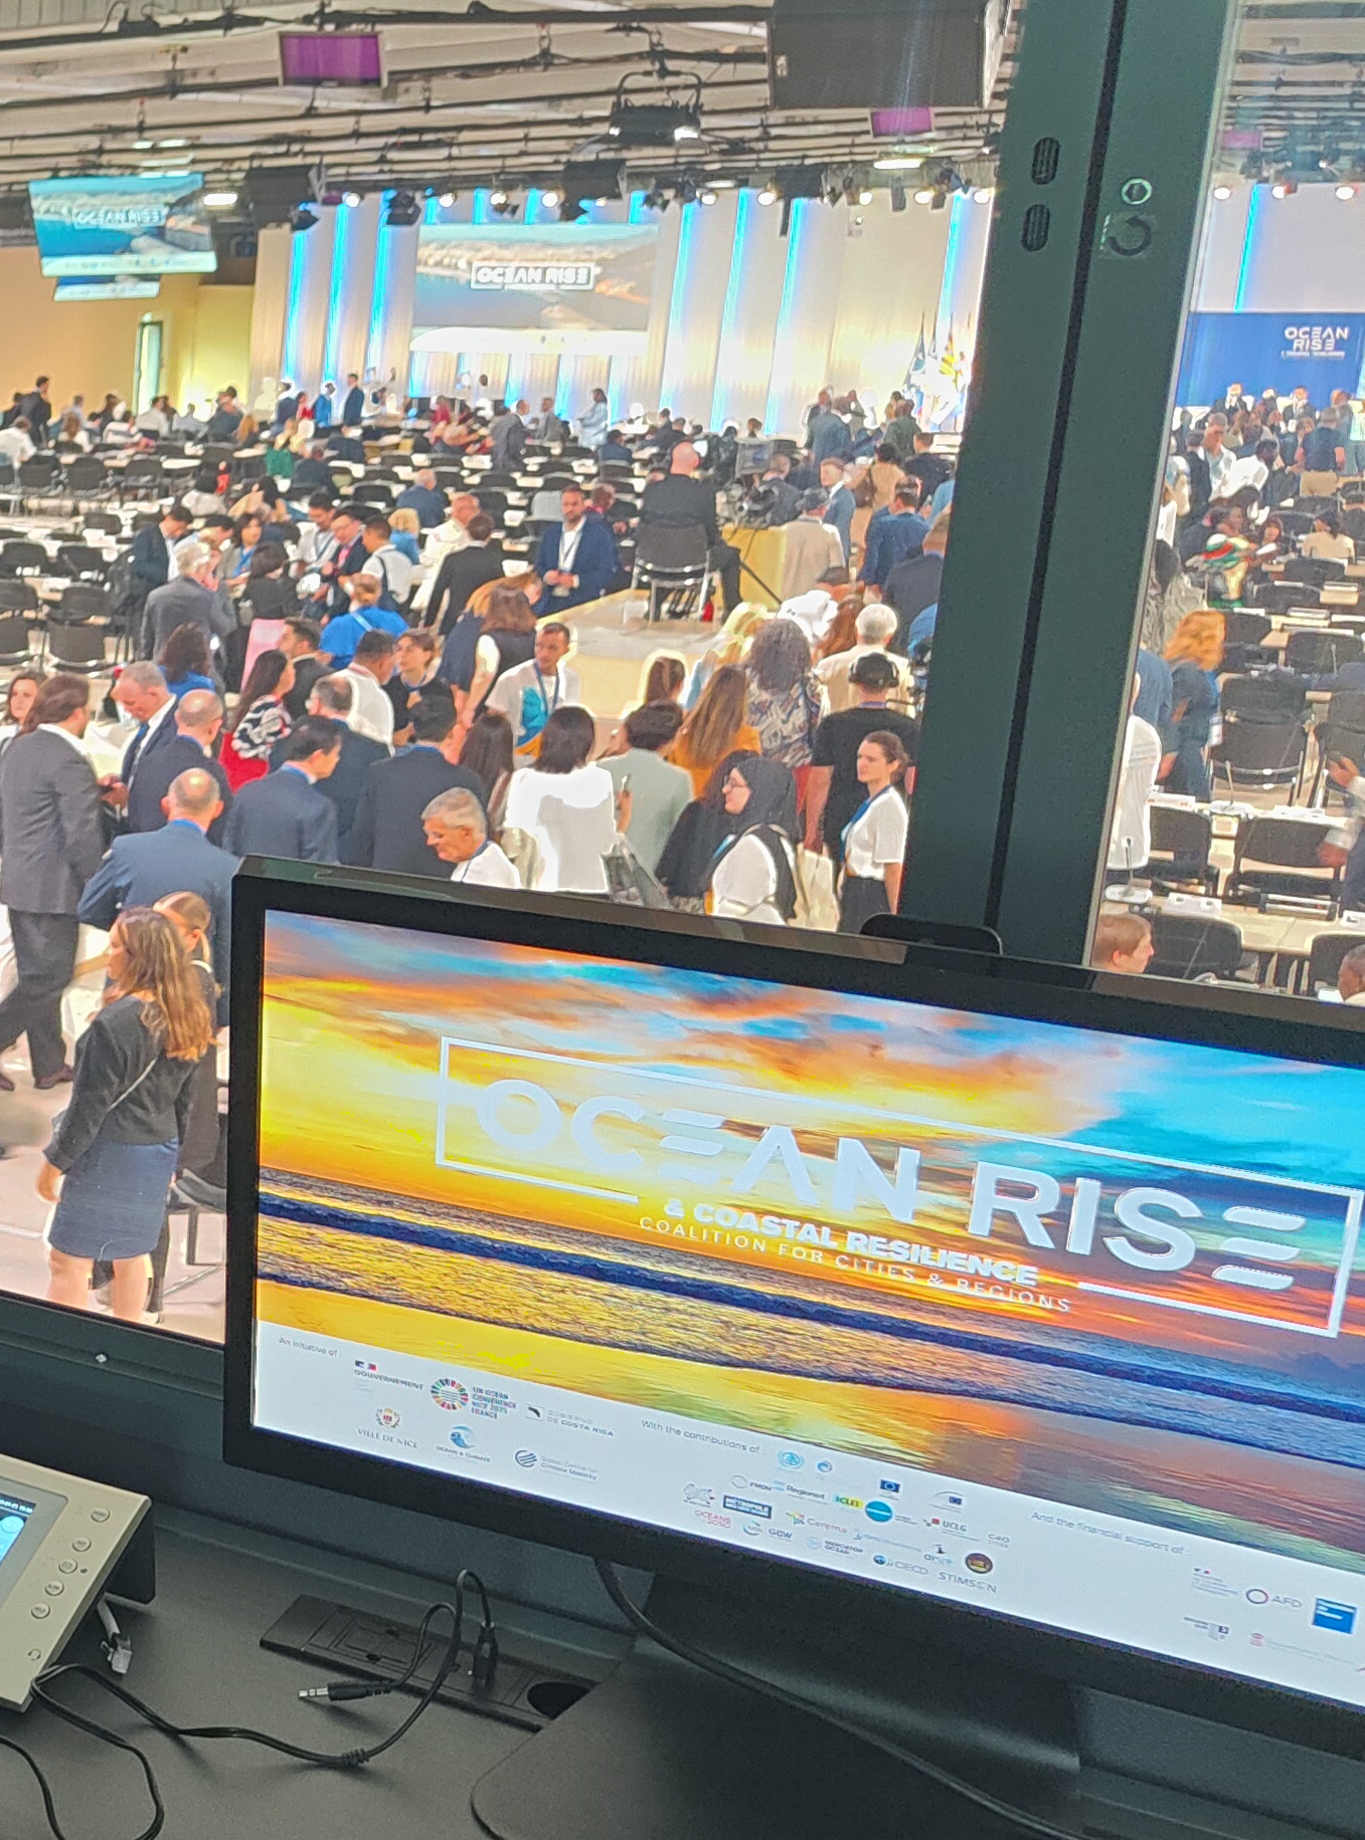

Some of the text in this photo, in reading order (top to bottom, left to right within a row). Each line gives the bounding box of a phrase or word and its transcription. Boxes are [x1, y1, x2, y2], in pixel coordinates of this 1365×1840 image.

[477, 266, 589, 284] OCEAN RISE
[1284, 326, 1349, 341] OCEAN
[1293, 339, 1336, 351] RISE
[475, 1079, 1310, 1291] OCEAN RISE
[663, 1198, 1039, 1287] & COASTAL RESILIENCE
[638, 1215, 1071, 1314] COALITION FOR CITIES & REGIONS
[357, 1427, 380, 1441] VILLE
[641, 1419, 761, 1453] With the contributions of
